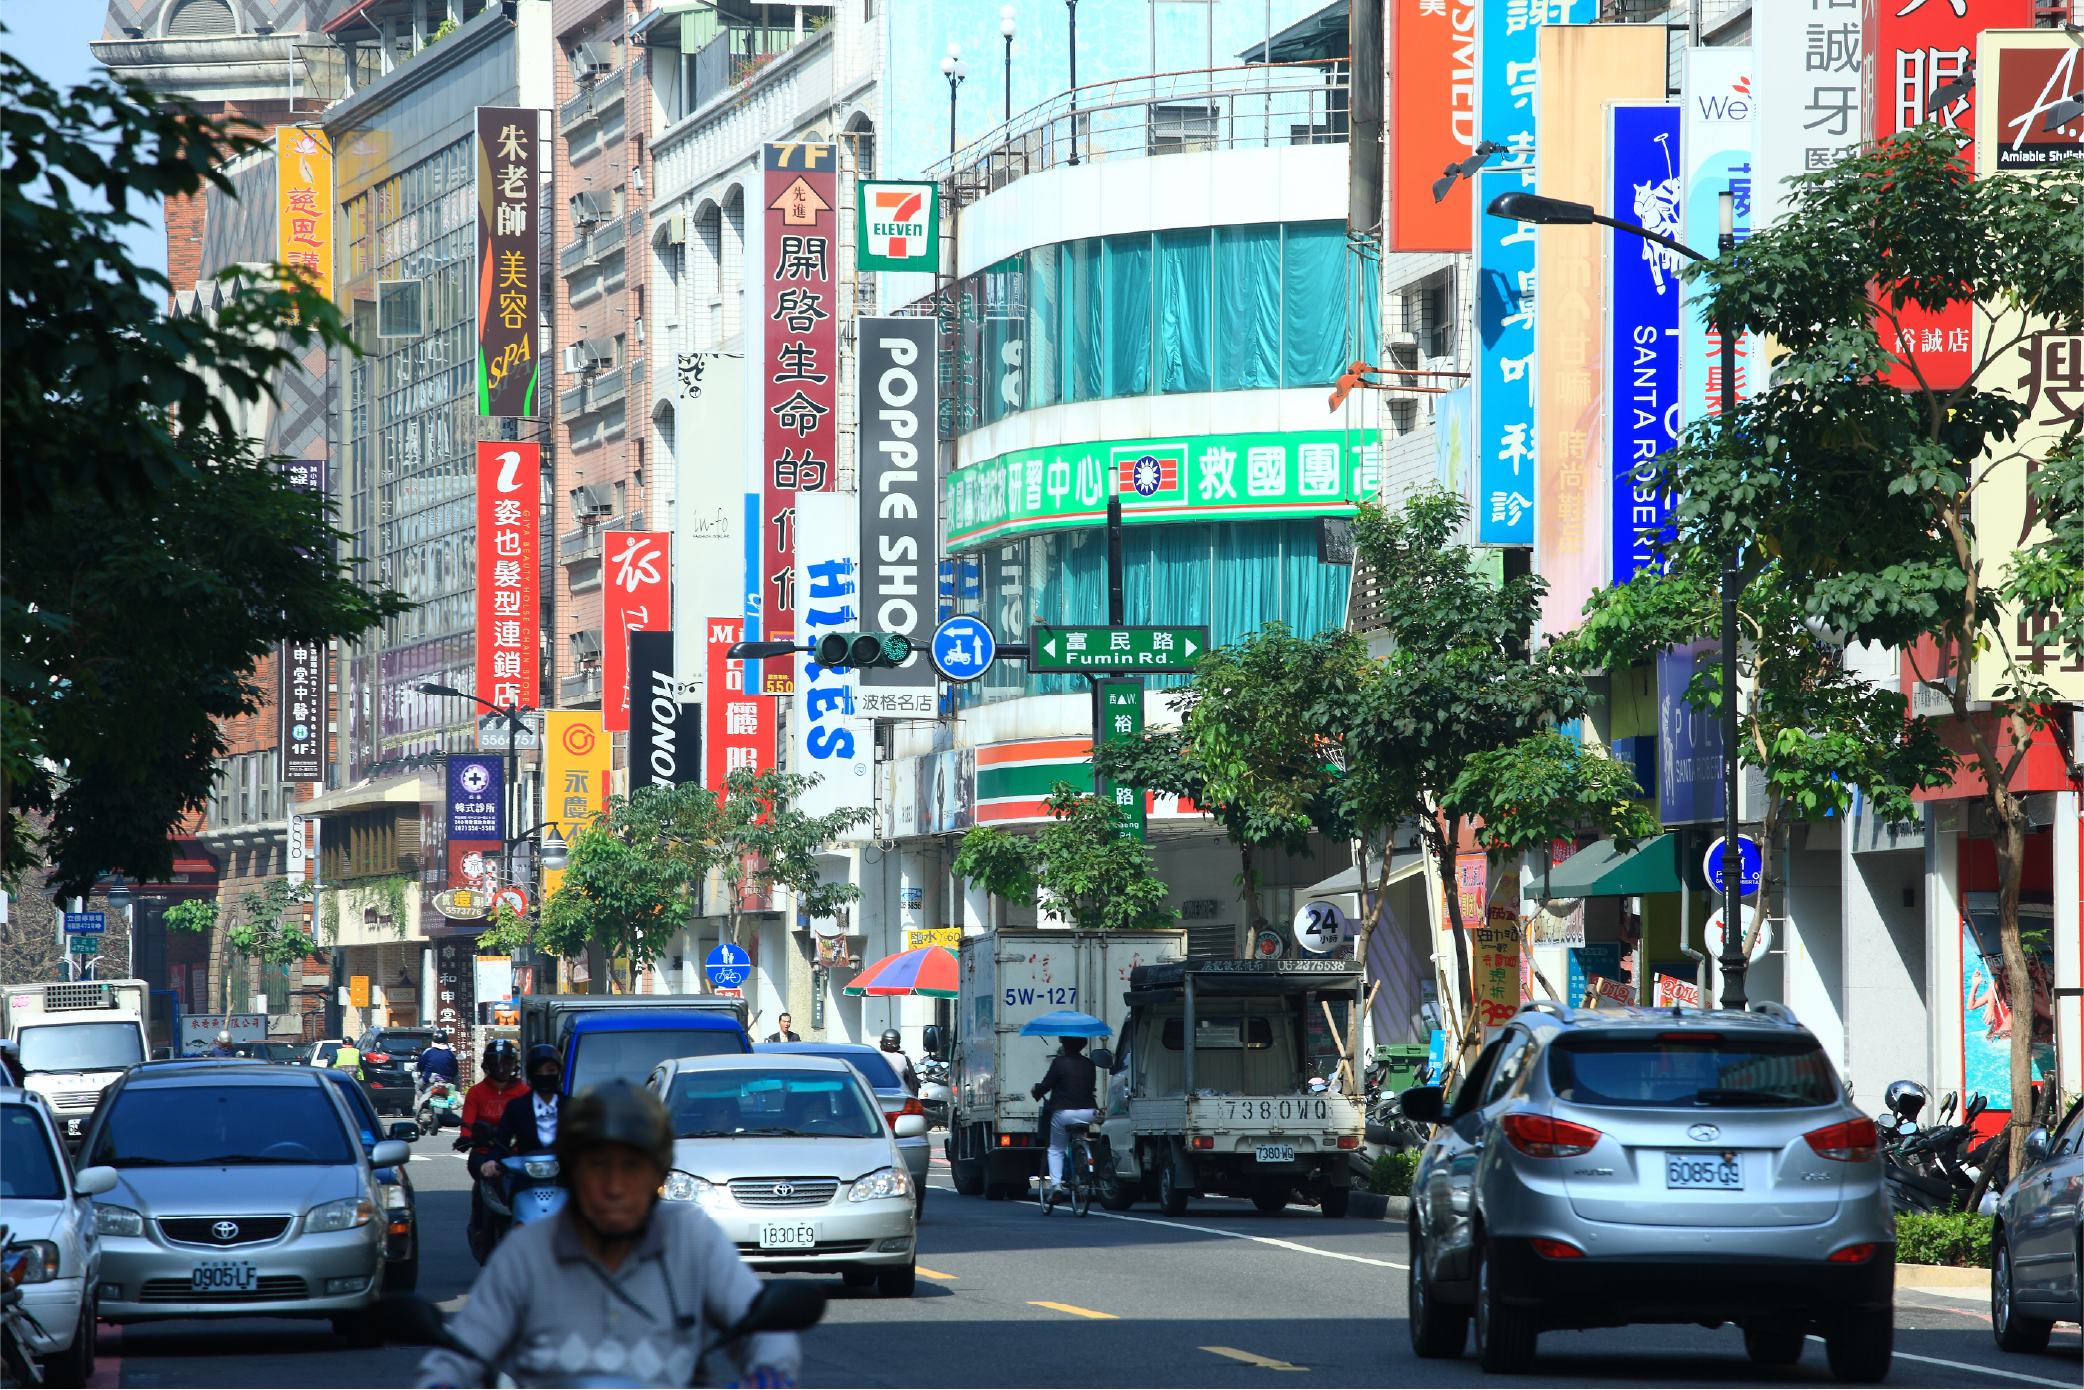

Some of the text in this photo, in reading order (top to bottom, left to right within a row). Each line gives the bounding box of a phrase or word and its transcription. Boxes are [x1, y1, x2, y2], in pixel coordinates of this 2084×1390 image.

[773, 144, 829, 168] 7F
[2001, 151, 2046, 162] Amiable
[497, 126, 528, 237] 朱老師
[791, 186, 806, 219] 先進
[499, 250, 528, 328] 美容
[1893, 327, 1970, 353] 裕誠店
[488, 333, 531, 389] SPA
[1633, 326, 1657, 421] SANTA
[1558, 430, 1588, 552] 時尚鞋品
[522, 510, 530, 535] GIYA
[522, 541, 530, 582] BEAUTY
[493, 499, 522, 708] 姿也髮型連鎖店
[522, 628, 530, 664] CHAIN
[1066, 632, 1174, 651] 富民路
[1066, 652, 1174, 665] Fumin Rd.
[862, 694, 932, 712] 波格名店
[1109, 694, 1117, 704] 西
[292, 743, 309, 755] 1F
[1114, 714, 1134, 806] 裕路
[1716, 870, 1760, 880] PLO
[444, 906, 482, 916] 5573776
[1305, 909, 1338, 935] 24
[1320, 935, 1338, 944] 小時
[1005, 988, 1077, 1006] 5W-127
[1670, 1162, 1739, 1183] 6085-G9
[763, 1228, 814, 1244] 1830-E9
